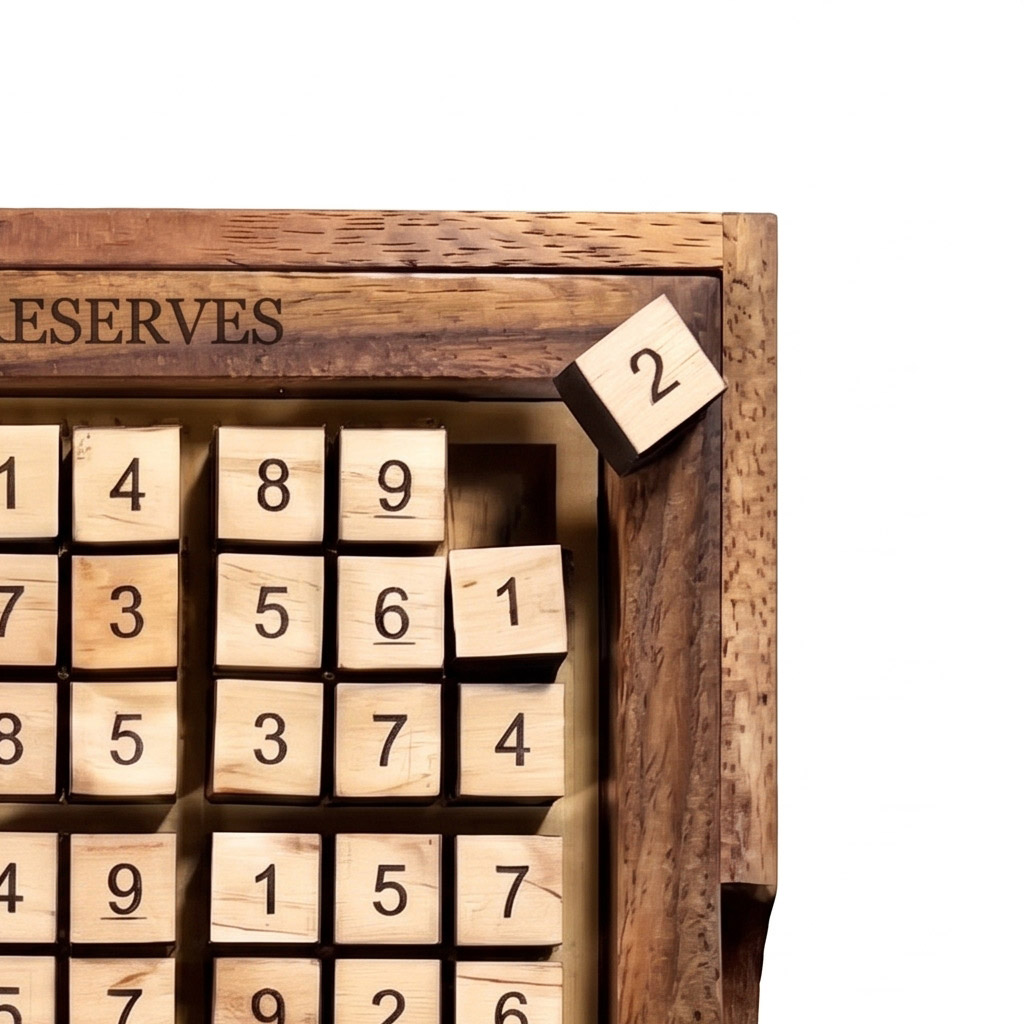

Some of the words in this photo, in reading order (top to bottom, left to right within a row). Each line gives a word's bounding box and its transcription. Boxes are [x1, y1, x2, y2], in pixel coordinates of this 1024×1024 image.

[631, 348, 680, 403] 2
[110, 458, 145, 511] 4
[258, 459, 290, 512] 8
[378, 460, 411, 511] 9
[110, 585, 144, 638] 3
[256, 586, 289, 638] 5
[375, 587, 409, 639] 6
[497, 577, 518, 626] 1
[111, 714, 143, 765] 5
[254, 713, 287, 764] 3
[373, 715, 407, 766] 7
[495, 713, 530, 766] 4
[108, 863, 142, 915] 9
[255, 864, 275, 914] 1
[373, 865, 407, 916] 5
[496, 866, 529, 918] 7
